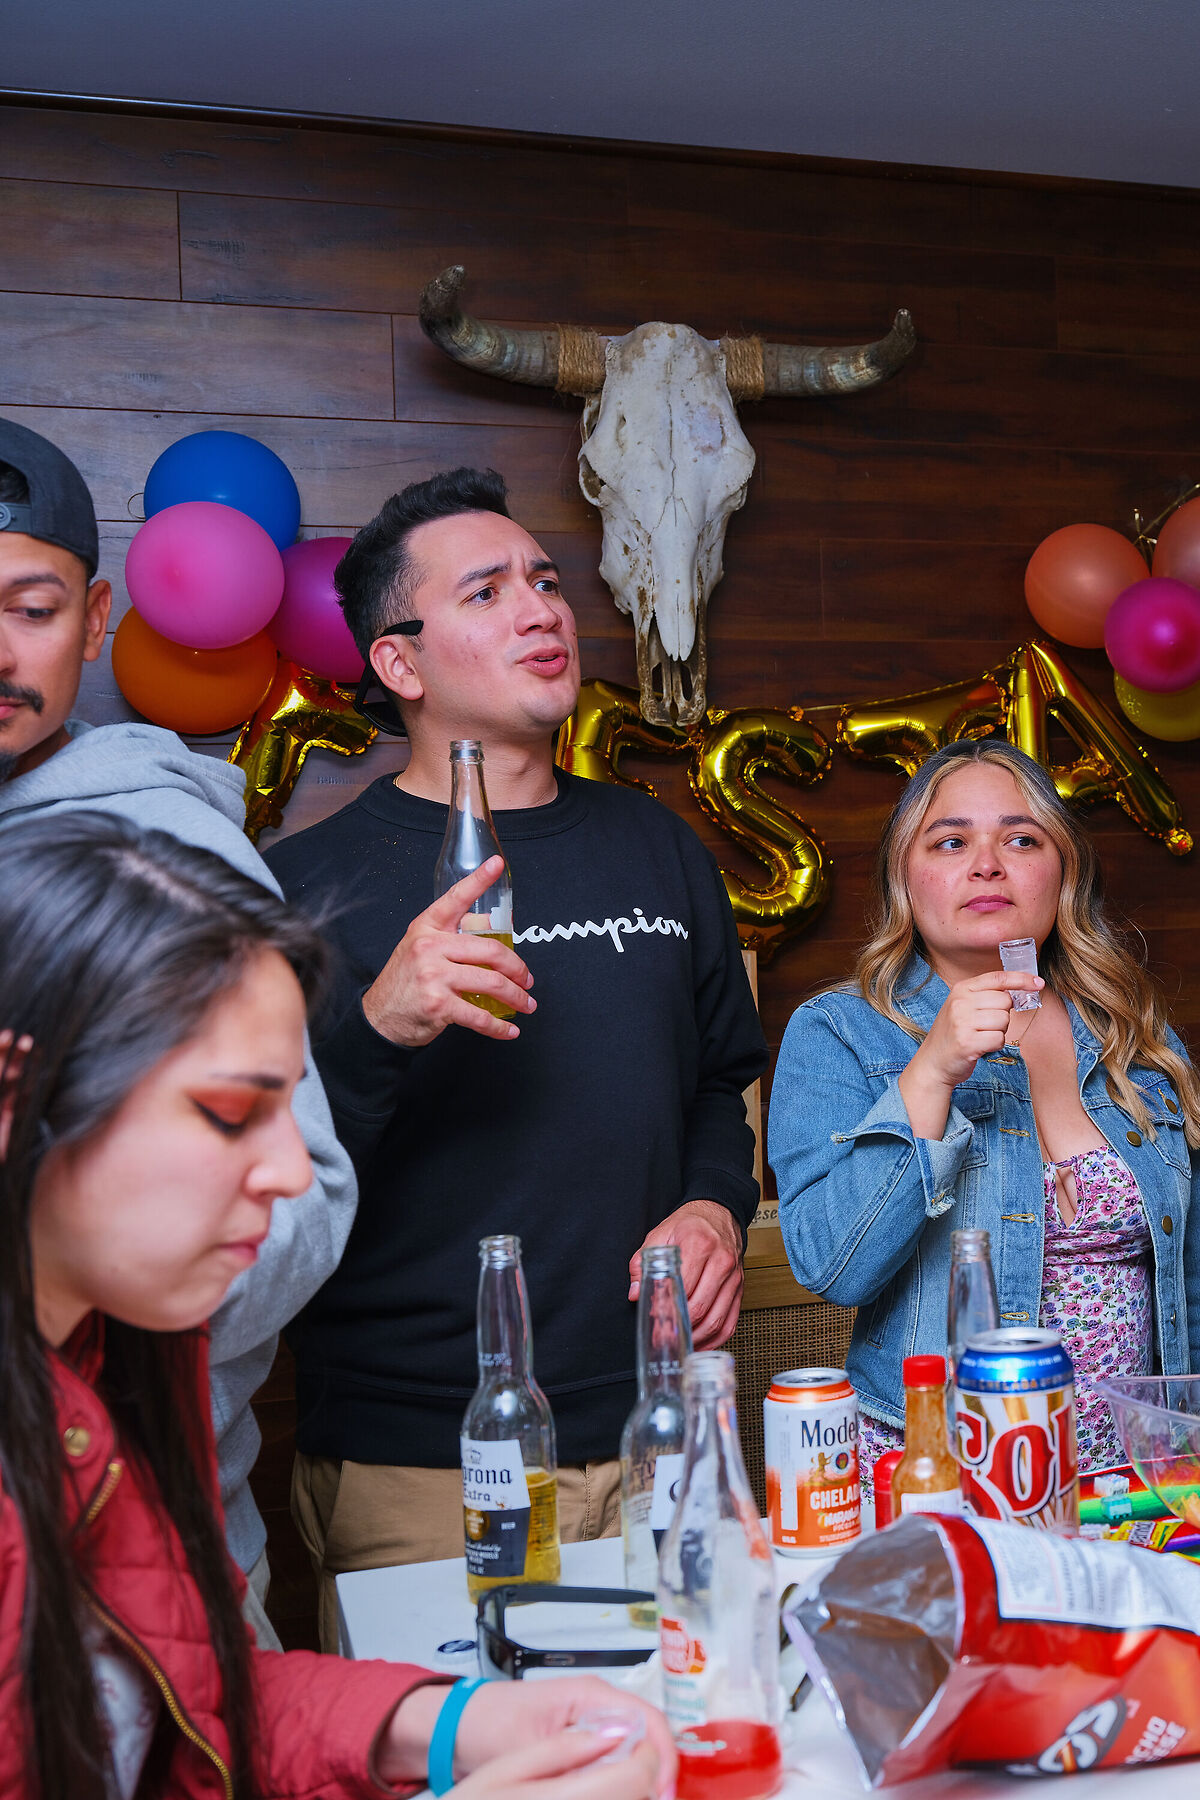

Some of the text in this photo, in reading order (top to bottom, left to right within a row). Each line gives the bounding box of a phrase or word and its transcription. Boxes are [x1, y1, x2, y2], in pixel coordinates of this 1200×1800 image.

[513, 907, 689, 952] ampion
[801, 1412, 859, 1448] Model
[462, 1466, 513, 1485] orona
